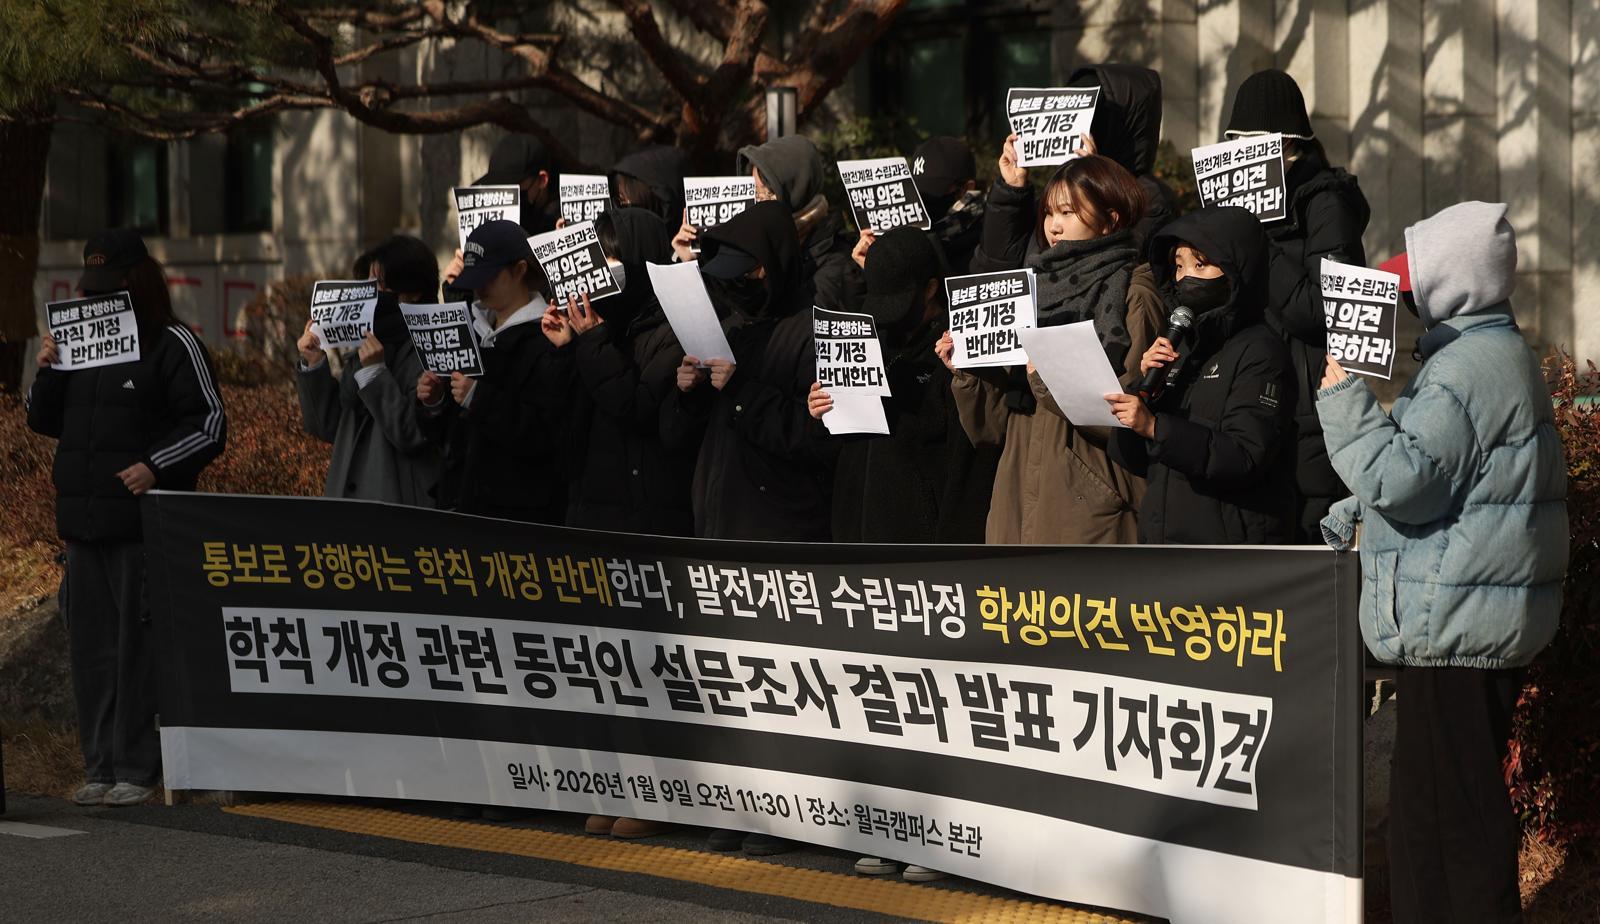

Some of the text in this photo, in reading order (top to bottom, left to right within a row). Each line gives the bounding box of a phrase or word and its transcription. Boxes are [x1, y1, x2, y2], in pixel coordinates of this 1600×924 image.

[1044, 93, 1093, 110] 강행하는
[1012, 112, 1078, 138] 학칙 개정
[1195, 139, 1281, 175] 발전계획 수립과정
[842, 163, 909, 185] 발전계획 수립과정
[1201, 163, 1267, 201] 학생 의견
[474, 191, 514, 208] 강행하는
[561, 184, 584, 197] 발전계획
[686, 183, 755, 201] 발전계획 수립과정
[850, 181, 906, 209] 학생 의견
[1217, 186, 1283, 215] 하라
[563, 202, 583, 222] 학생
[690, 204, 716, 227] 학생
[866, 201, 923, 232] 반영하라
[556, 227, 596, 251] 수립과정
[560, 248, 594, 277] 의견
[340, 285, 375, 301] 강행하는
[554, 266, 612, 305] 반영하라
[952, 278, 1023, 306] 통보로 강행하는
[1347, 277, 1398, 300] 수립과정
[81, 299, 126, 319] 강행하는
[313, 302, 365, 326] 학칙 개정
[431, 309, 466, 325] 수립과정
[952, 301, 1015, 334] 학칙 개정
[1335, 302, 1383, 333] 의견
[54, 316, 120, 346] 학칙 개정
[323, 322, 371, 344] 반대한다
[412, 328, 461, 351] 학생 의견
[831, 320, 872, 336] 강행하는
[71, 334, 136, 365] 반대한다
[425, 348, 476, 372] 반영하라
[835, 342, 867, 363] 개정
[1327, 331, 1392, 366] 영하라
[819, 366, 883, 388] 반대한다
[202, 542, 1286, 673] 통보로 강행하는 학칙 개정 반대한다, 발전계획 수립과정 학생의견 반영하라
[225, 615, 1268, 795] 학칙 개정 관련 동덕인 설문조사 결과 발표 기자회견
[508, 763, 551, 792] 일시:
[553, 768, 626, 799] 2026년
[627, 775, 658, 803] 1월
[659, 779, 694, 807] 9일
[697, 782, 736, 812] 오전
[736, 789, 791, 819] 11:30
[806, 797, 850, 827] 장소:
[853, 803, 944, 847] 월곡캠퍼스
[948, 821, 983, 858] 본관
